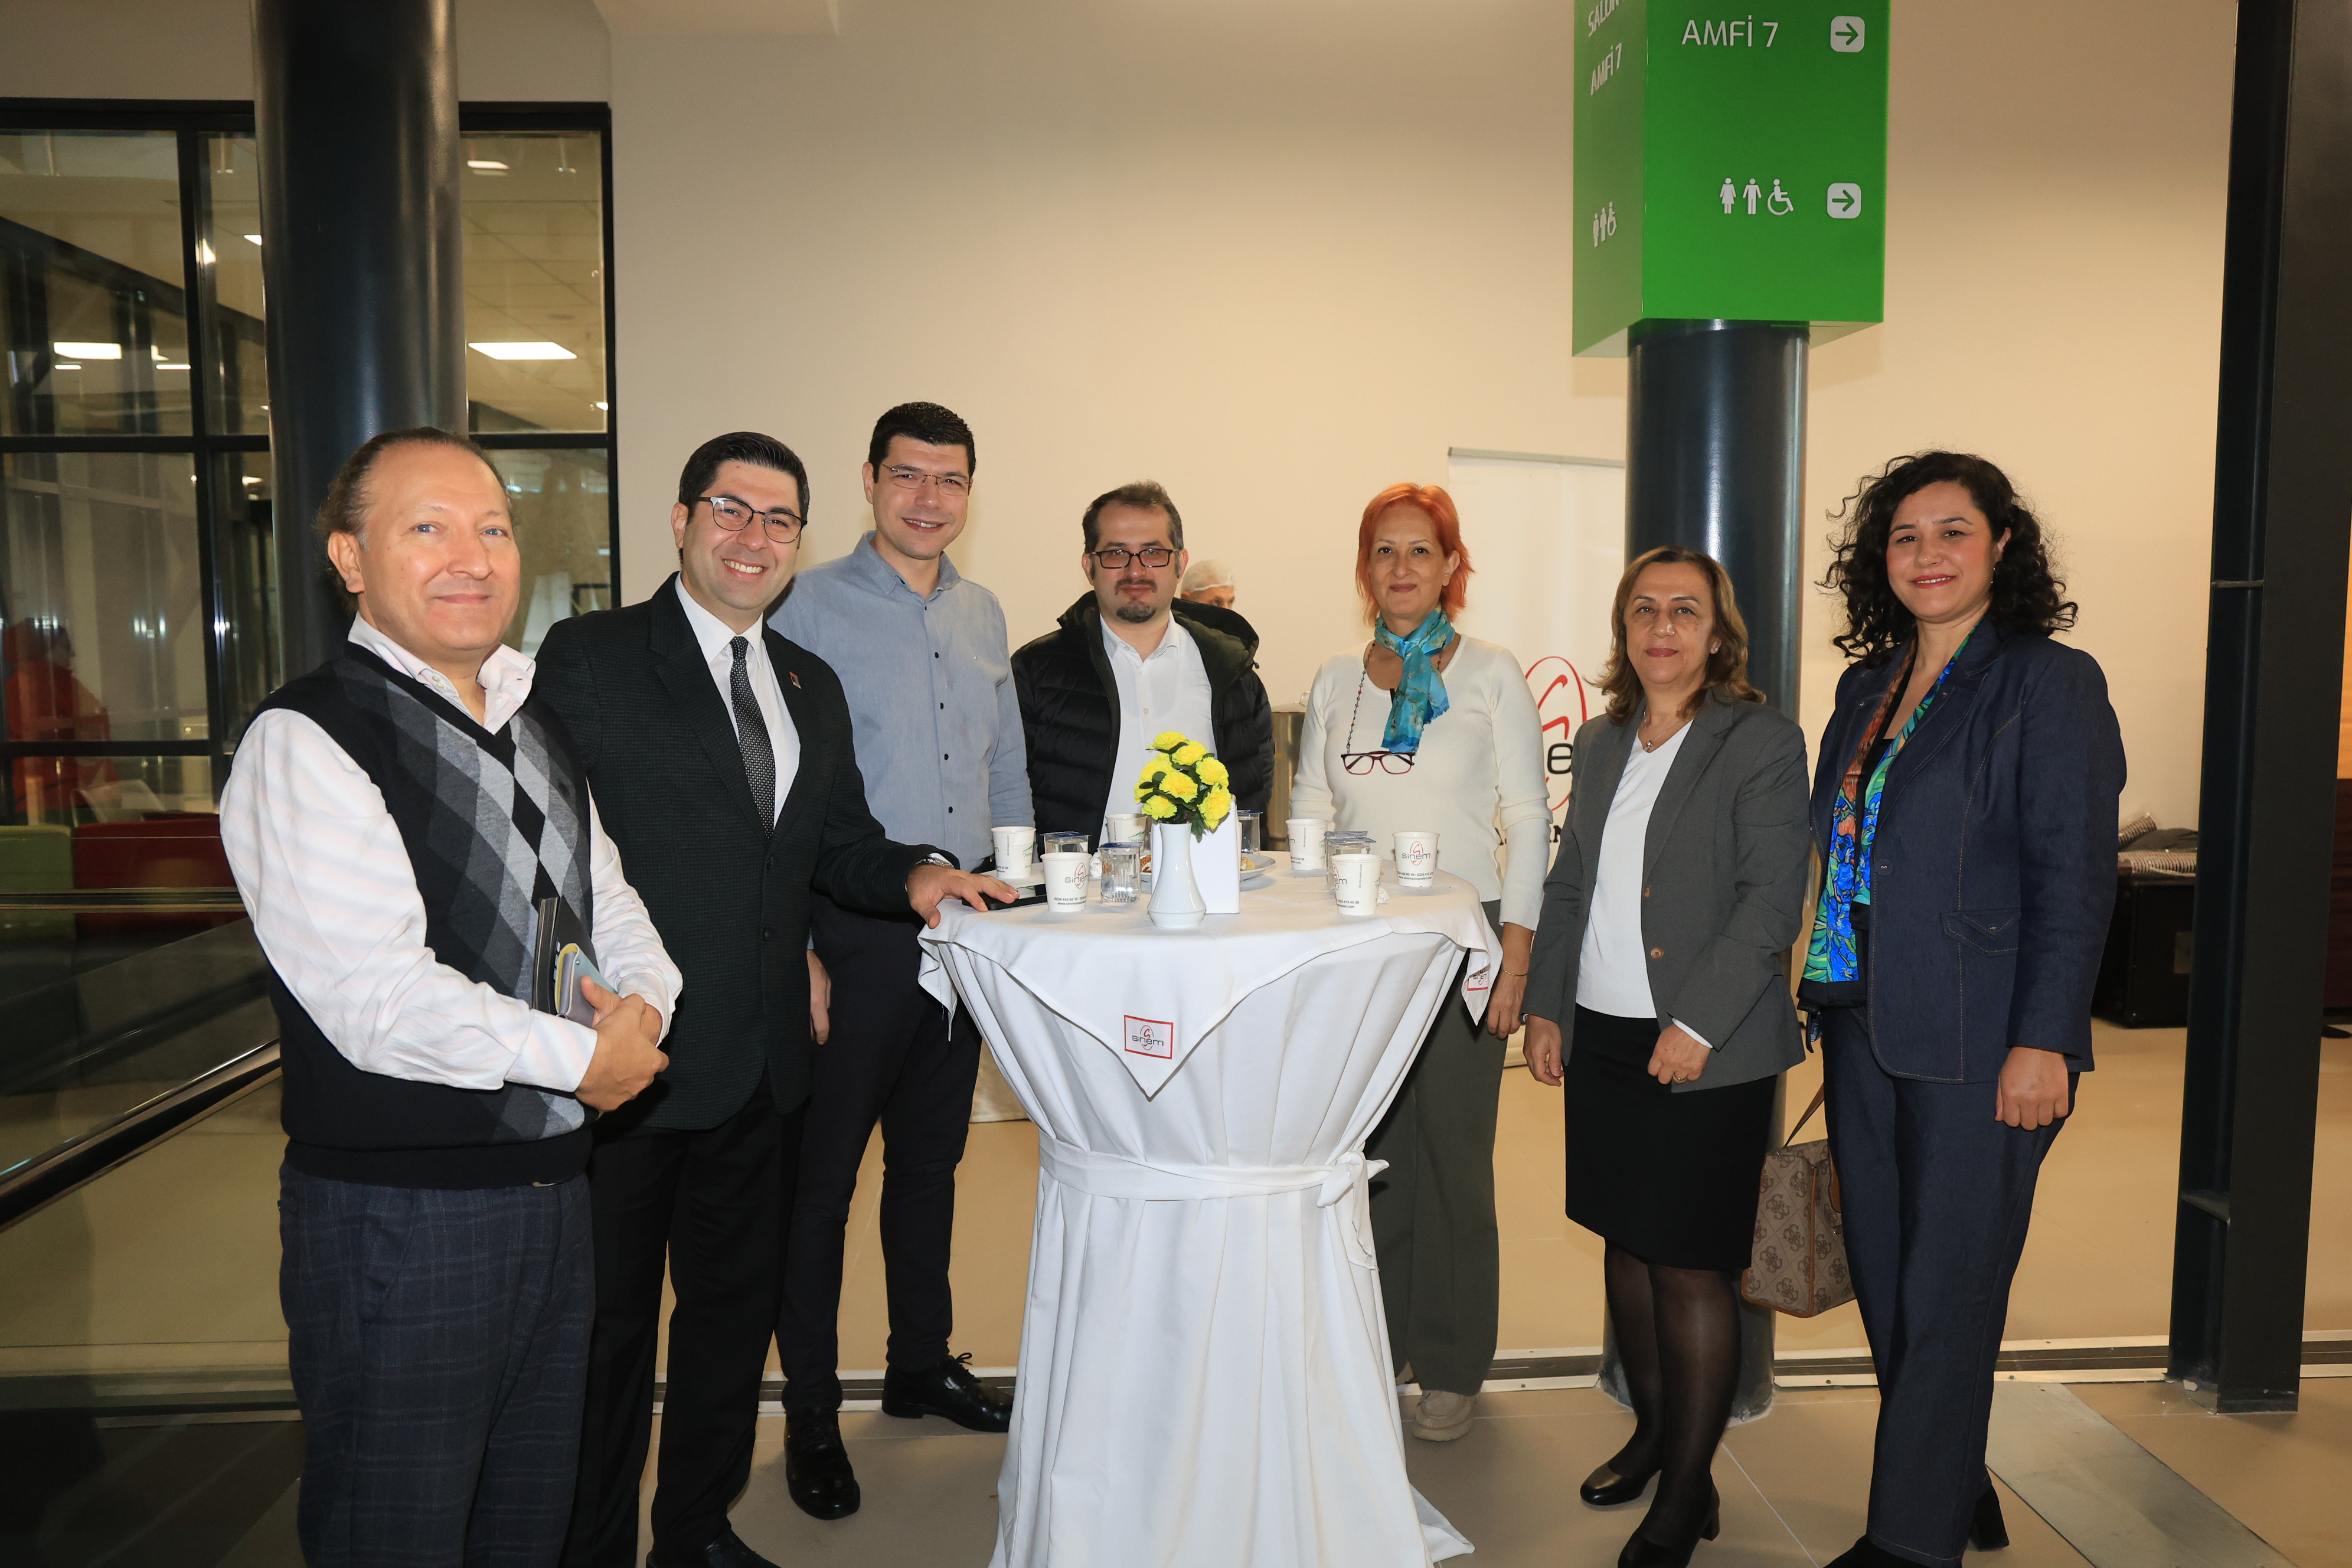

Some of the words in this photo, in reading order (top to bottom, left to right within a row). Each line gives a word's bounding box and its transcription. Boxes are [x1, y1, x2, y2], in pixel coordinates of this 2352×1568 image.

[1681, 14, 1752, 47] AMFİ
[1762, 21, 1779, 48] 7
[1590, 45, 1614, 96] AMFİ
[1615, 43, 1622, 70] 7
[1132, 1035, 1164, 1047] sinem
